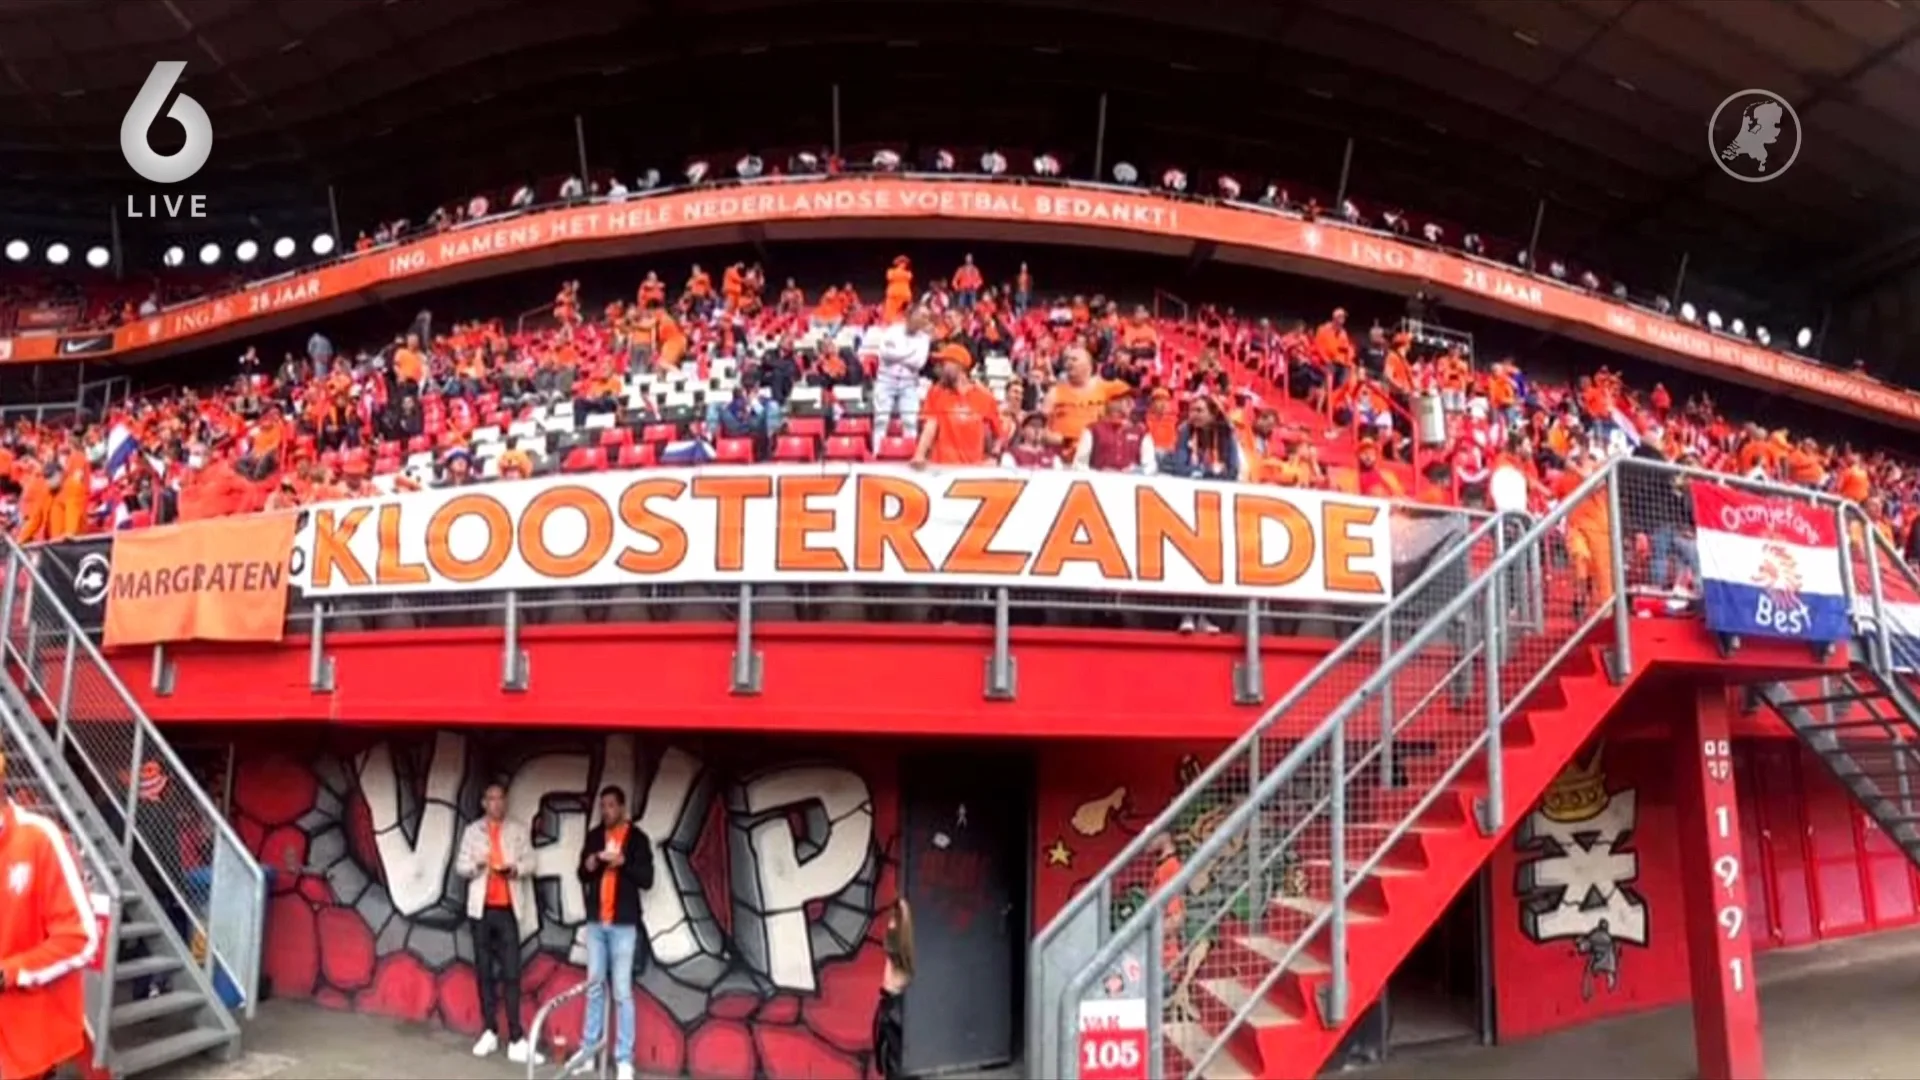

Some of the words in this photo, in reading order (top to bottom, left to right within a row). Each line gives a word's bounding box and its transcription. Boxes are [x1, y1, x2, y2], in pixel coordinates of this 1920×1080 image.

[440, 224, 541, 260] NAMENS
[552, 214, 600, 236] HET
[608, 204, 672, 229] HELE
[684, 190, 891, 221] NEDERLANDSE
[900, 190, 1025, 213] VOETBAL
[272, 279, 321, 307] JAAR
[1351, 240, 1405, 268] ING
[1495, 276, 1543, 306] JAAR
[311, 475, 1385, 594] KLOOSTERZANDE
[1755, 593, 1812, 634] Best
[1083, 1015, 1121, 1032] VAK
[1083, 1040, 1140, 1070] 105
